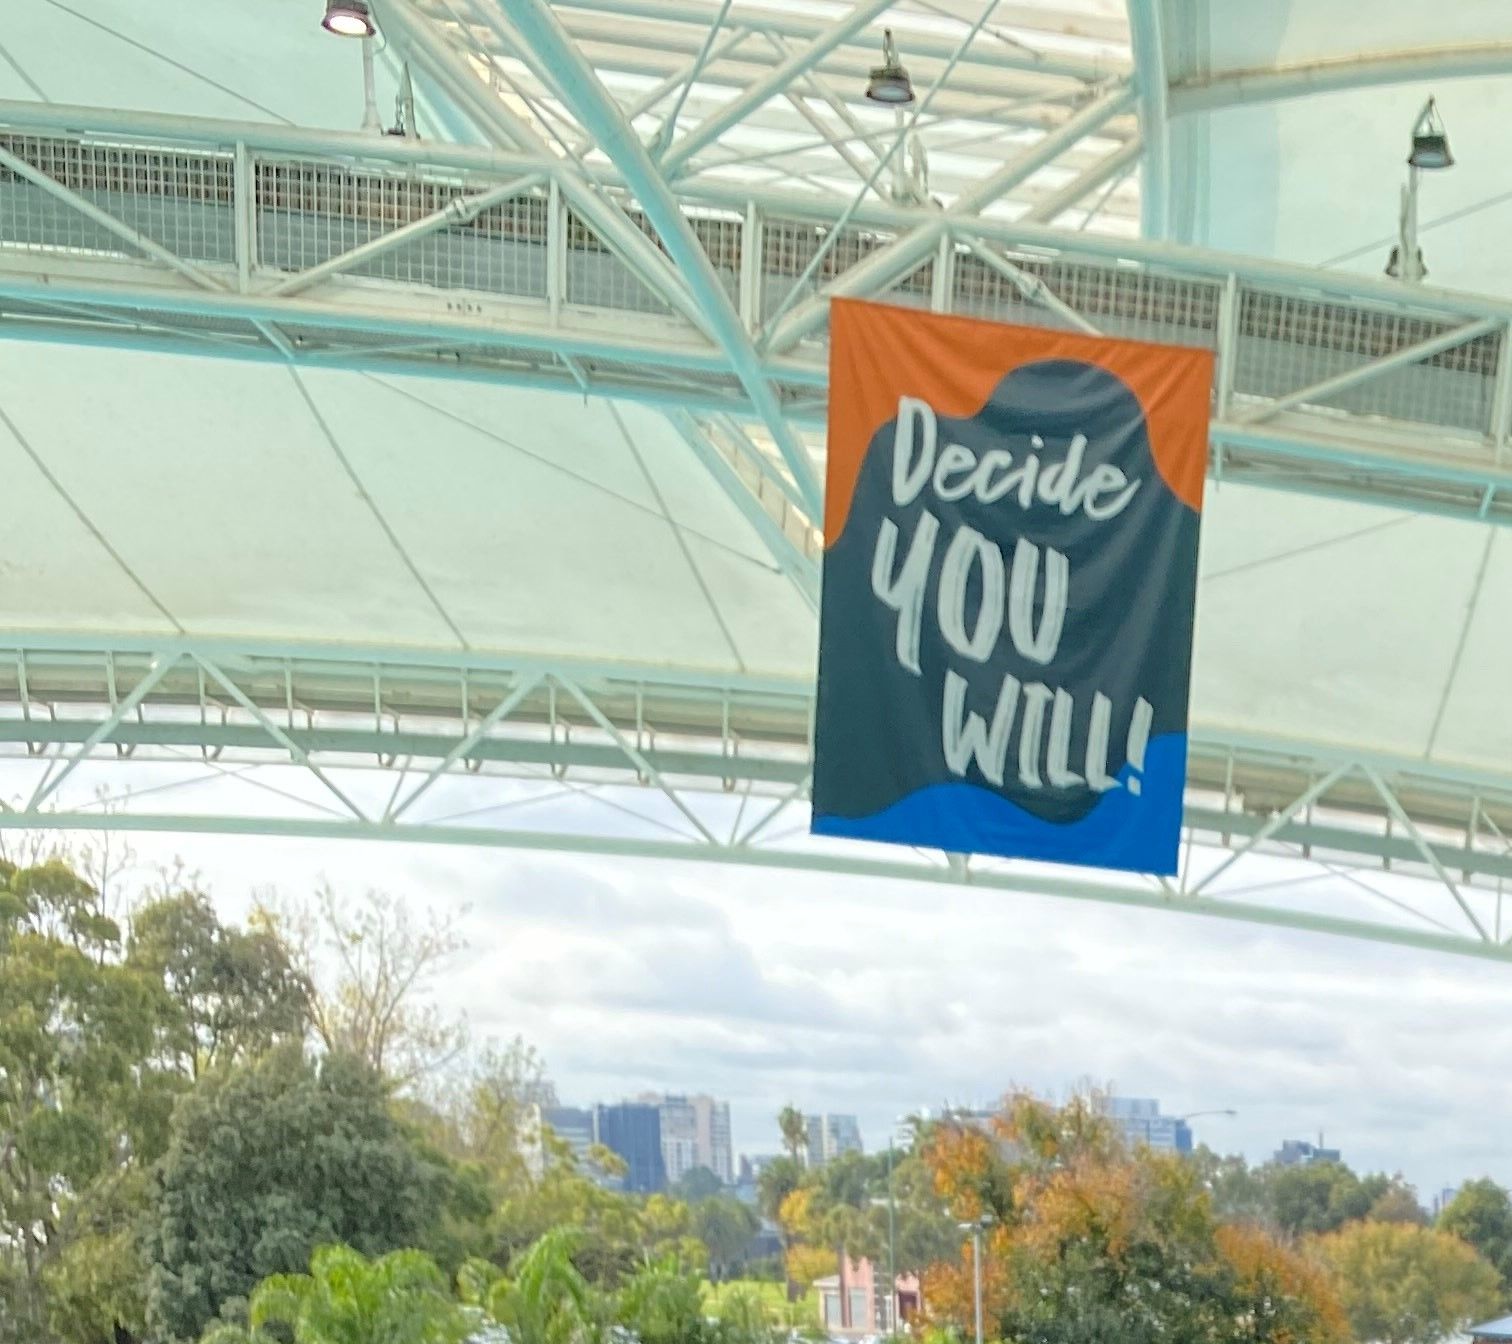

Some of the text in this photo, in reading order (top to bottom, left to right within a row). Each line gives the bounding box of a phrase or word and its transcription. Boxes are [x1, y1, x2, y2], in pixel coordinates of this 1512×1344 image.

[891, 395, 1142, 520] Decide
[871, 509, 1069, 676] YOU
[942, 668, 1154, 796] WILL!
